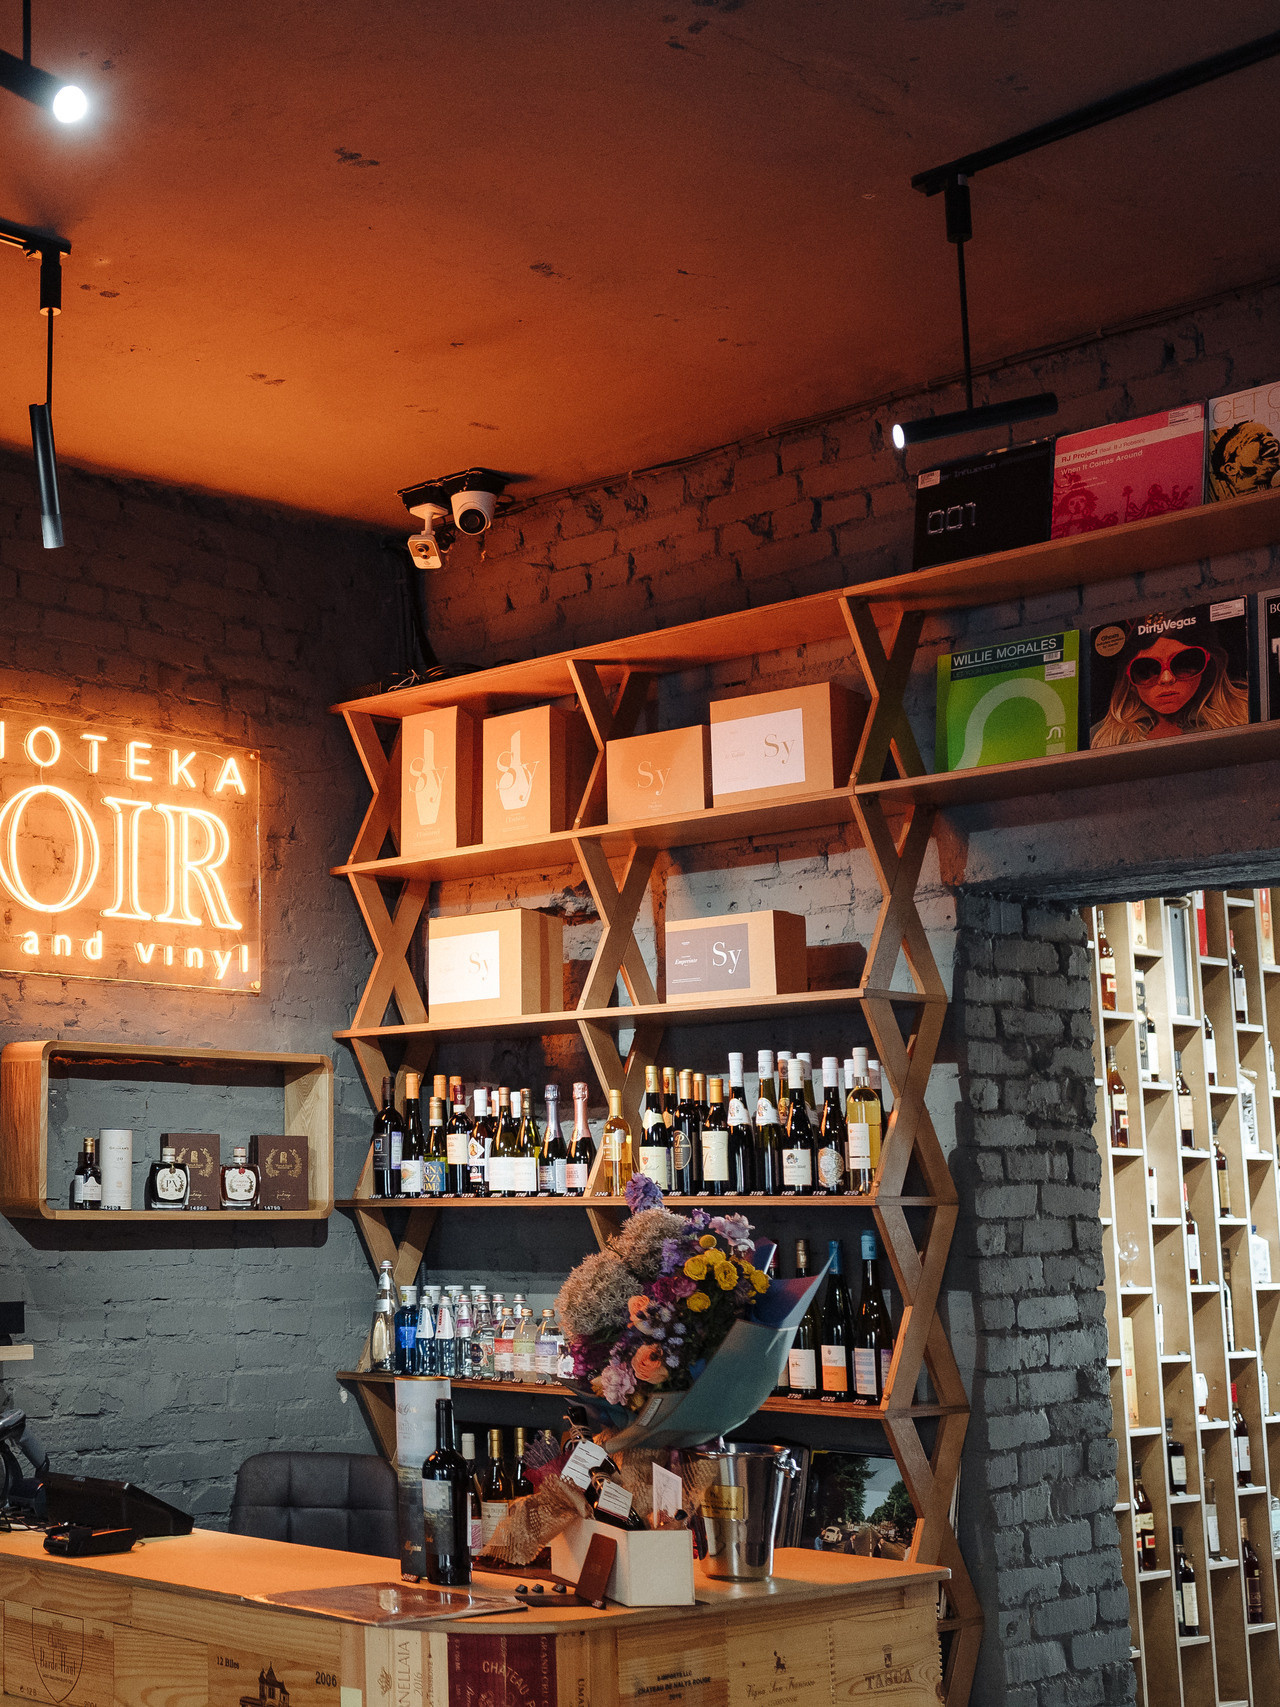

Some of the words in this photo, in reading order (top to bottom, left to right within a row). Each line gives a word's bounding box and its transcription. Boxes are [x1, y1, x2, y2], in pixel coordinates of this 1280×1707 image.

[1089, 458, 1114, 469] Comes
[1115, 449, 1144, 462] Around
[953, 649, 993, 667] WILLIE
[996, 638, 1057, 659] MORALES
[764, 733, 796, 765] Sy
[408, 757, 449, 803] Sy
[496, 751, 540, 802] Sy
[637, 760, 671, 796] Sy
[21, 930, 104, 961] and
[135, 942, 249, 980] vinyl
[712, 941, 742, 975] Sy
[315, 1671, 337, 1687] 2006
[413, 1672, 423, 1696] 2016
